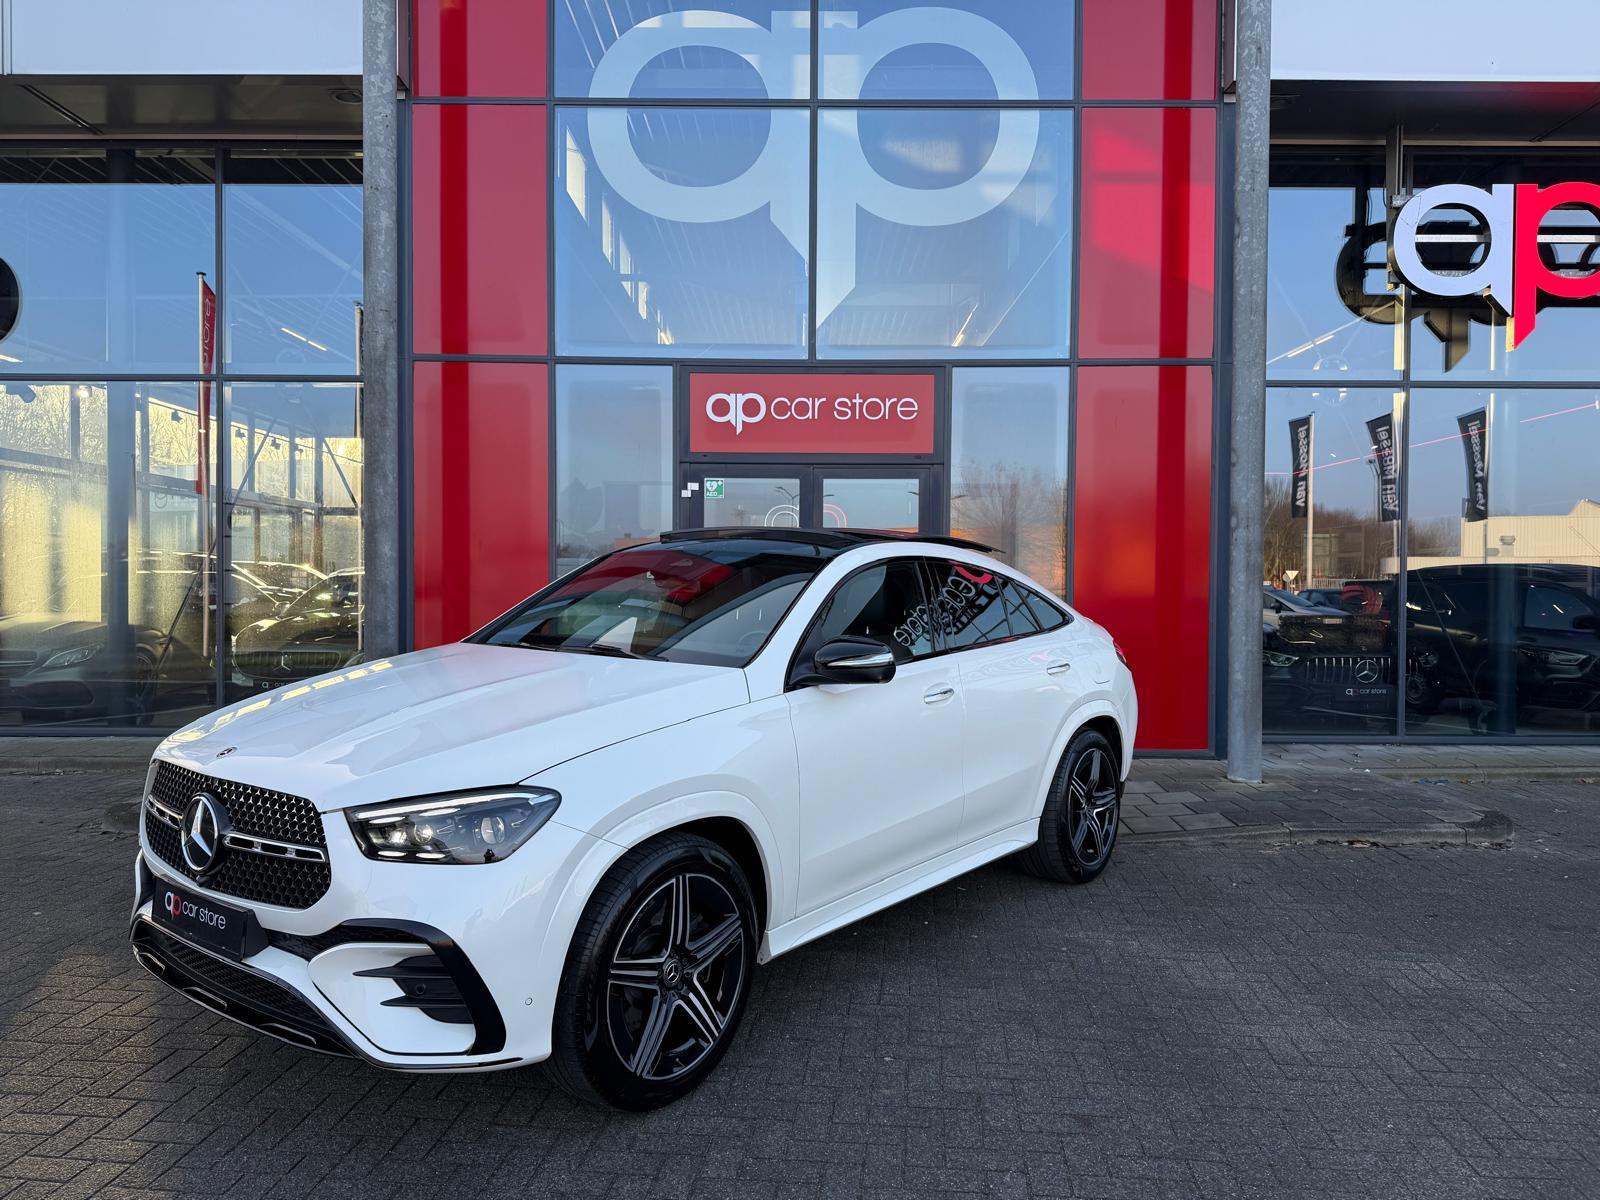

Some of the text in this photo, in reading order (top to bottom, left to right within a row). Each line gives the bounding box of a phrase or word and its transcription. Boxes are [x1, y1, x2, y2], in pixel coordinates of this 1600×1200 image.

[587, 6, 1040, 329] ap
[705, 392, 918, 435] ap car store
[165, 891, 226, 930] ap car store
